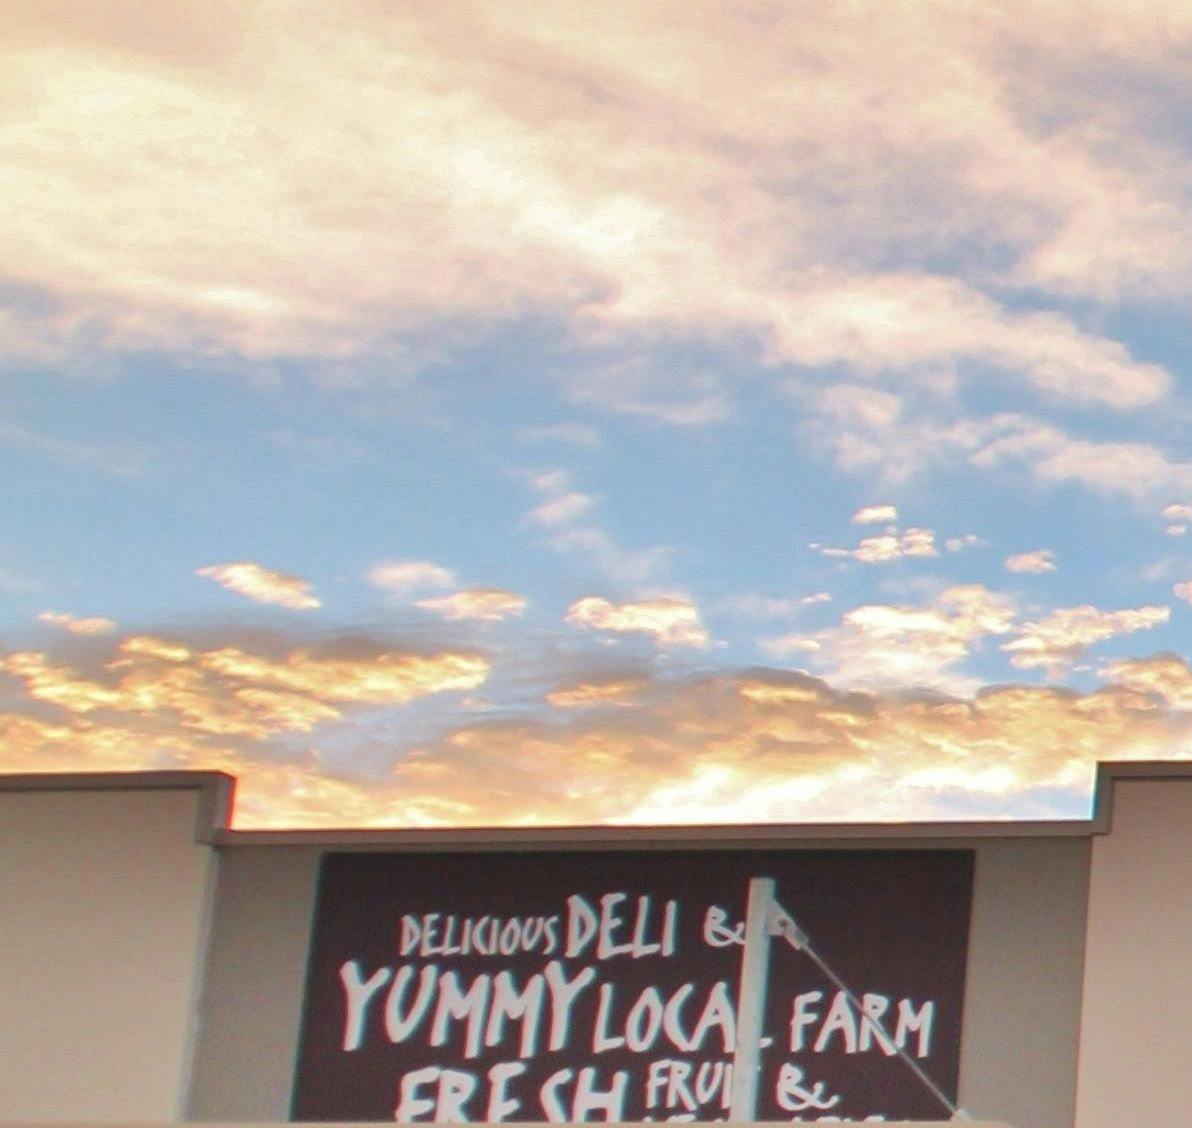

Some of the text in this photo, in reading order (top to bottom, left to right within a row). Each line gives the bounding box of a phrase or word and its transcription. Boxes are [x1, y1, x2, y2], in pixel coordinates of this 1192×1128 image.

[400, 893, 748, 960] DELICIOUS DELI &
[339, 959, 934, 1058] YUMMY LOCA FARM
[645, 1059, 735, 1110] FRUI
[777, 1063, 840, 1110] &
